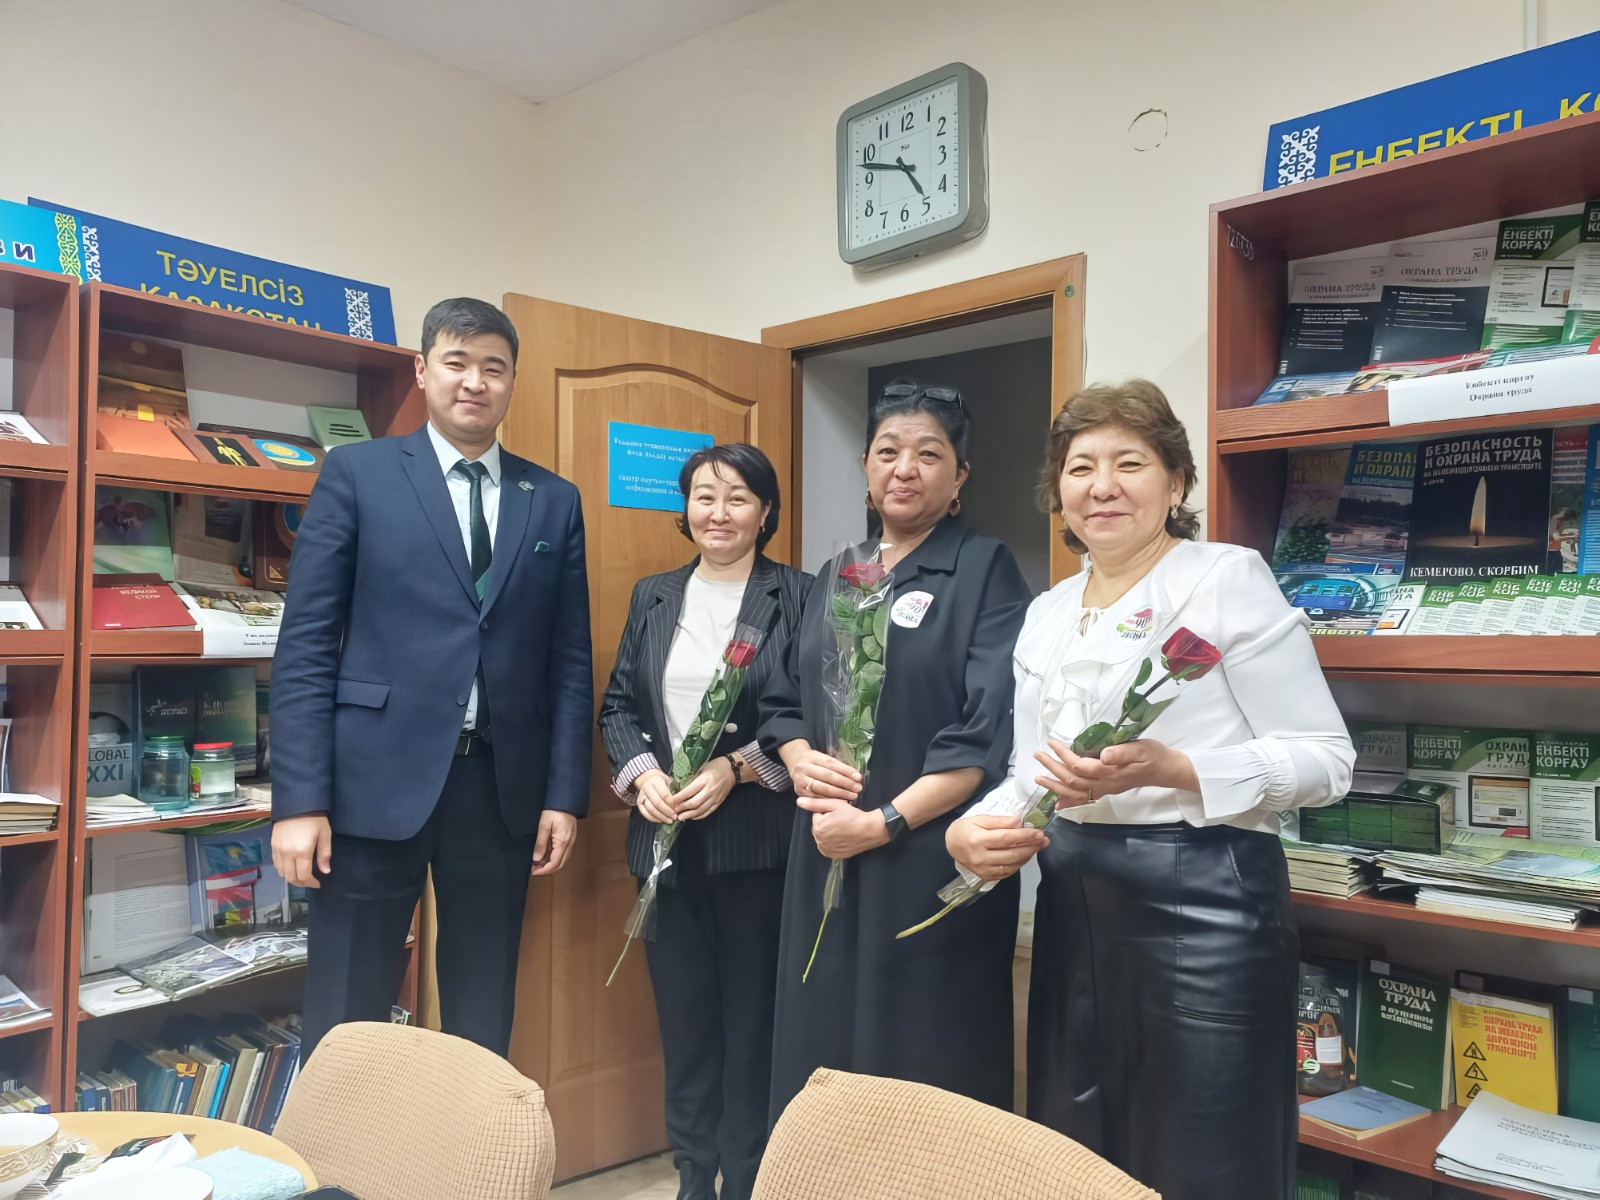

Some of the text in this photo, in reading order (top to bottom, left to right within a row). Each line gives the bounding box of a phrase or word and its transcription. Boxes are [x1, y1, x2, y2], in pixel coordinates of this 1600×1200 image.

[879, 121, 889, 141] 11
[900, 112, 914, 133] 12
[936, 116, 946, 137] 2
[863, 143, 876, 163] 10
[936, 144, 947, 166] 3
[864, 171, 874, 190] 9
[937, 173, 947, 193] 4
[864, 200, 874, 217] 8
[900, 203, 910, 222] 6
[921, 196, 931, 216] 5
[879, 211, 889, 229] 7
[1425, 435, 1543, 457] БЕЗОПАСНОСТЬ
[1356, 450, 1417, 463] БЕЗОПА
[1424, 448, 1542, 469] И ОХРАНА ТРУДА
[1409, 564, 1540, 578] КЕМЕРОВО. СКОРБИМ
[88, 749, 130, 762] LOBAL
[1485, 741, 1528, 752] ОХРАН
[1487, 752, 1530, 767] ТРУД
[87, 763, 124, 783] XXI
[1378, 978, 1437, 1002] ОХРАНА
[1384, 990, 1431, 1012] ТРУДА
[1483, 1015, 1543, 1035] ОХРАНА ТРУДА
[1485, 1024, 1497, 1034] НА
